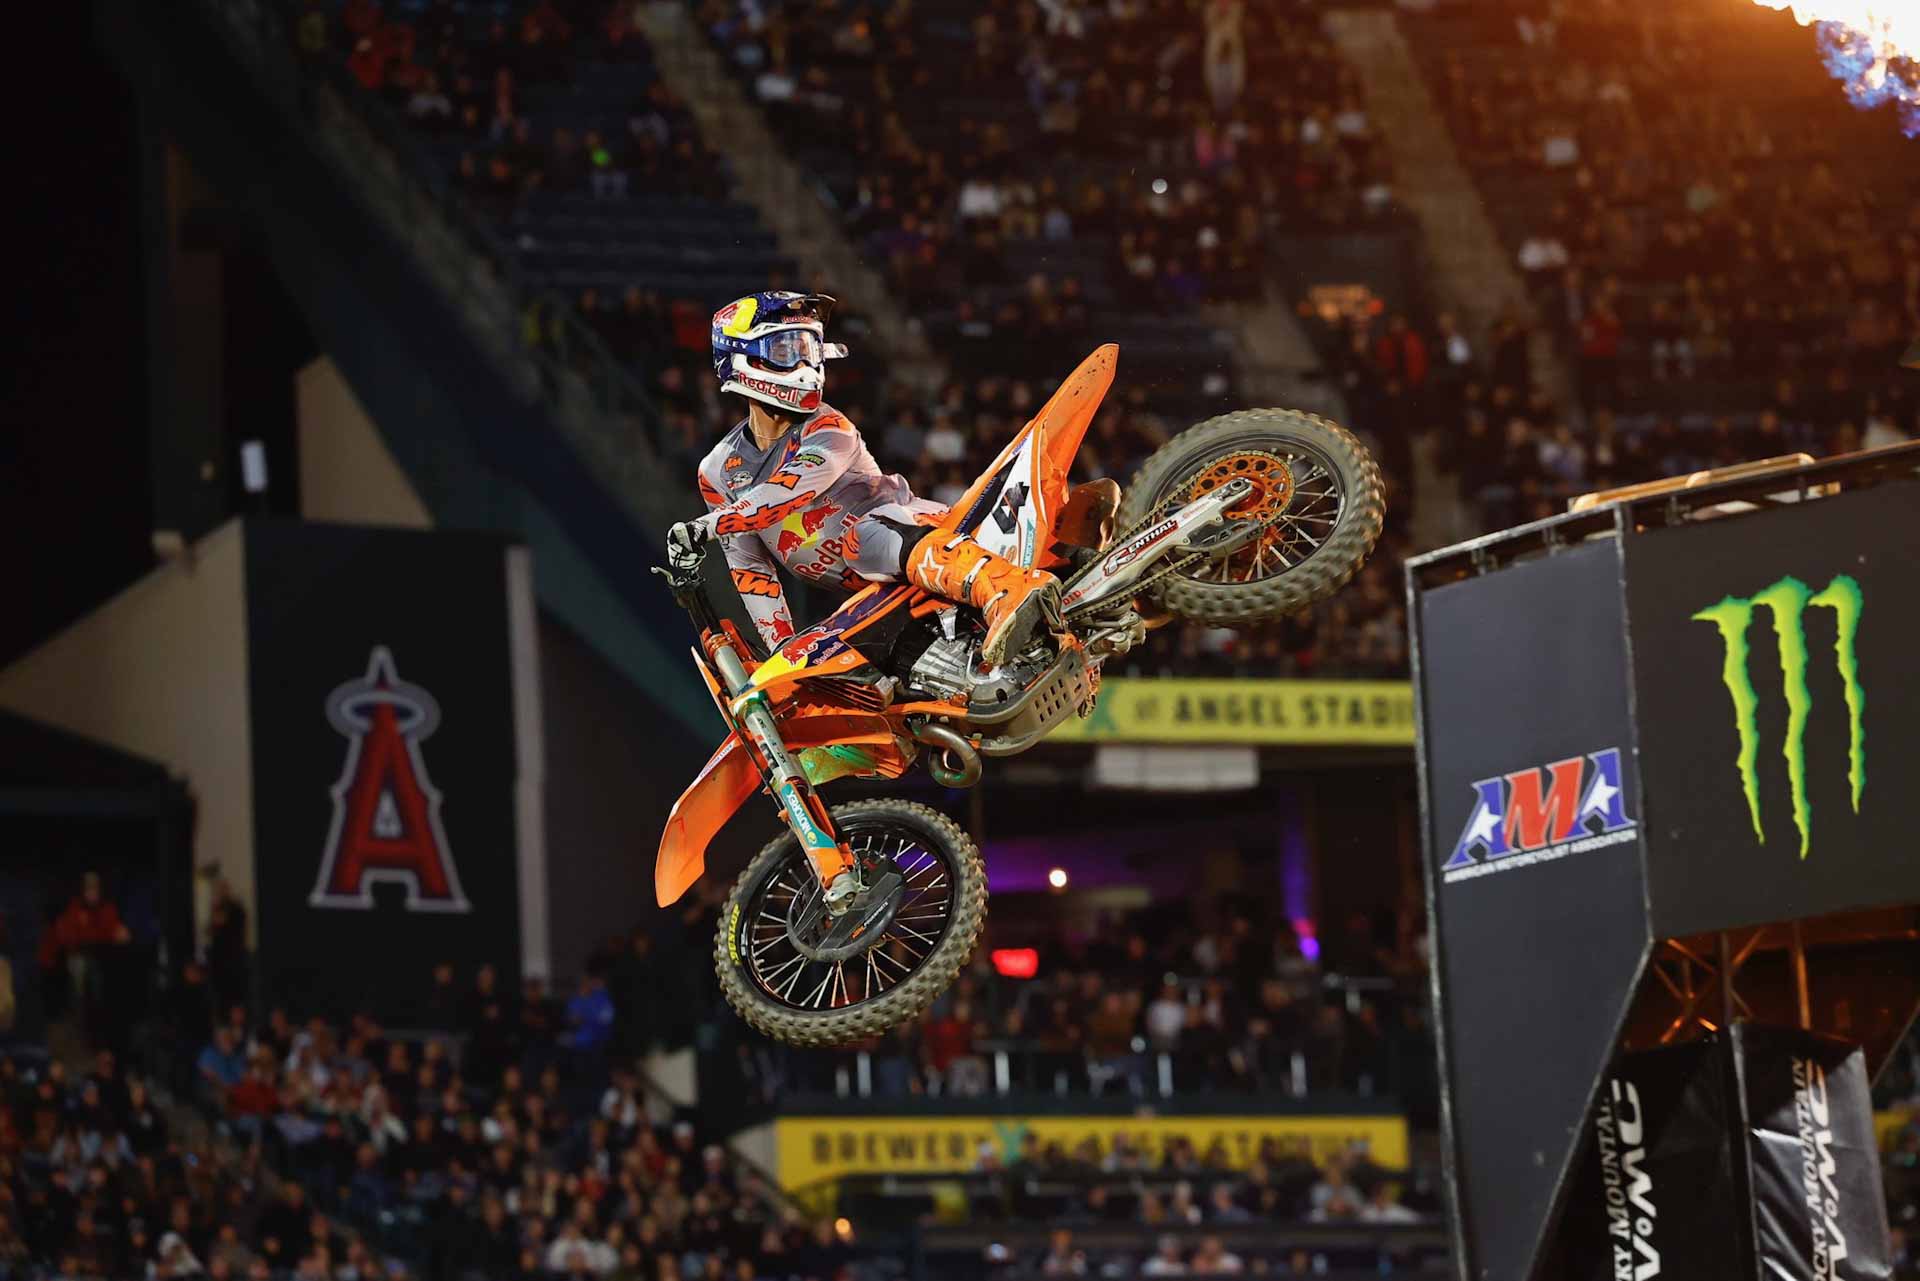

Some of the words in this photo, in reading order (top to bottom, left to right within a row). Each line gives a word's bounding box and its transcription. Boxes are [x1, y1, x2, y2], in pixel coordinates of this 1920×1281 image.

[991, 481, 1030, 534] 4
[1103, 518, 1179, 576] RENTHAL
[1174, 693, 1287, 727] ANGEL
[309, 645, 473, 913] A
[785, 790, 812, 835] MOTOREX
[1441, 746, 1638, 872] AMA
[728, 904, 741, 962] DUNLOP
[1792, 1058, 1824, 1217] MOUNTAIN
